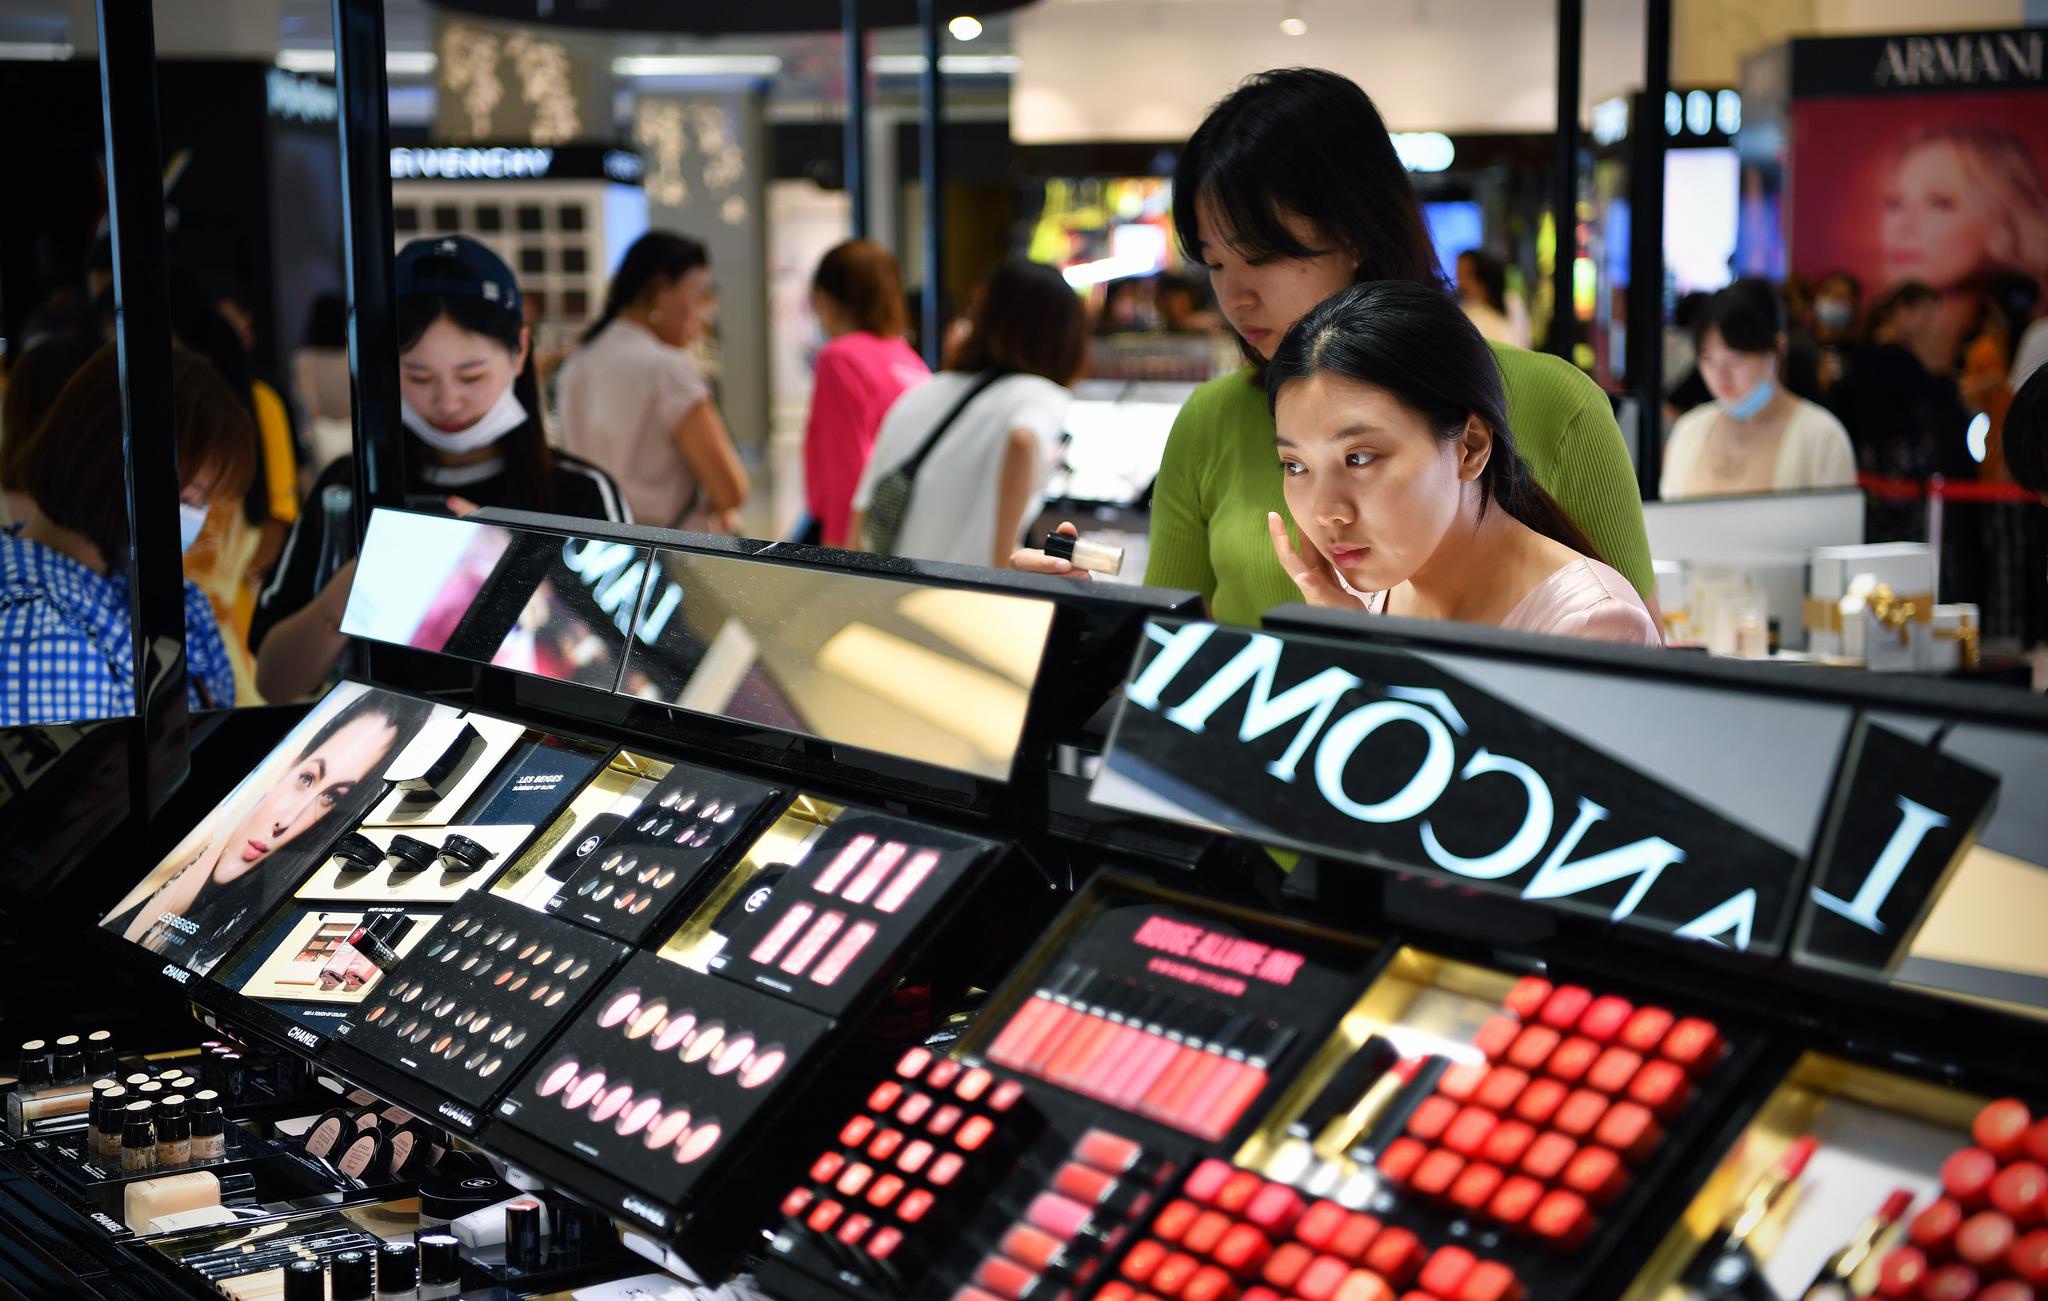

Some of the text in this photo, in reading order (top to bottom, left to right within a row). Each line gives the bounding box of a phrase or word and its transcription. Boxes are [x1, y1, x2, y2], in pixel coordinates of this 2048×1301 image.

[1874, 32, 2043, 87] ARMANI
[158, 911, 200, 935] LES BEIGES
[162, 963, 192, 985] CHANEL
[287, 1026, 321, 1049] CHANEL
[438, 1100, 476, 1128] CHANEL
[90, 1212, 125, 1234] CHANEL
